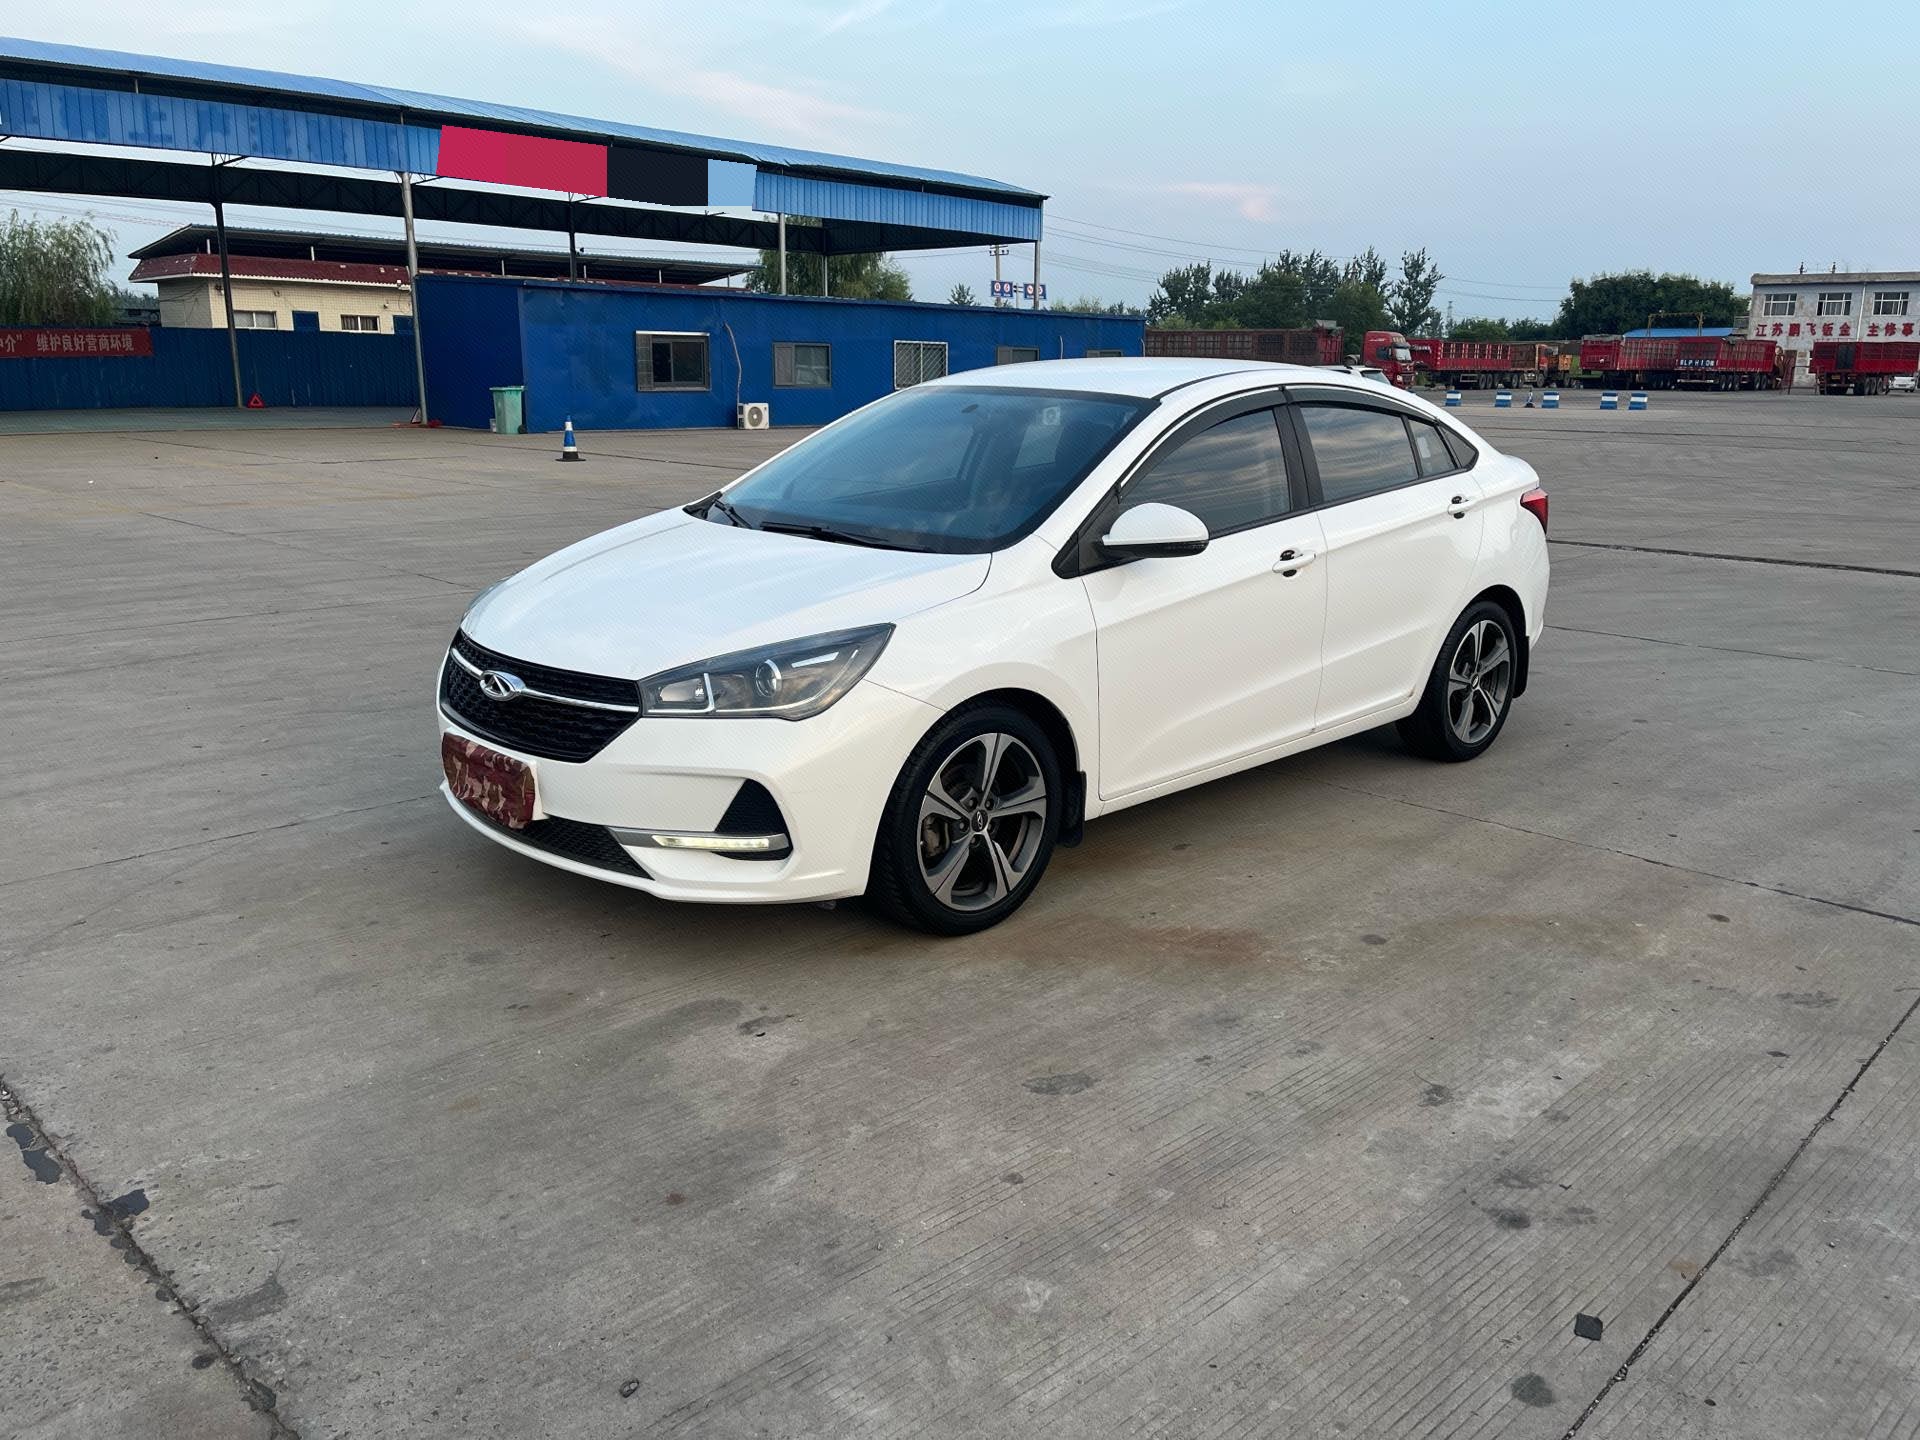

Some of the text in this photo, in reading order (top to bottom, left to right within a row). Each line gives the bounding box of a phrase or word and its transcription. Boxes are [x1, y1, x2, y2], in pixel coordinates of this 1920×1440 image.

[1755, 322, 1920, 337] 江苏鹏飞钣金 主修事
[37, 334, 134, 352] 维护良好营商环境
